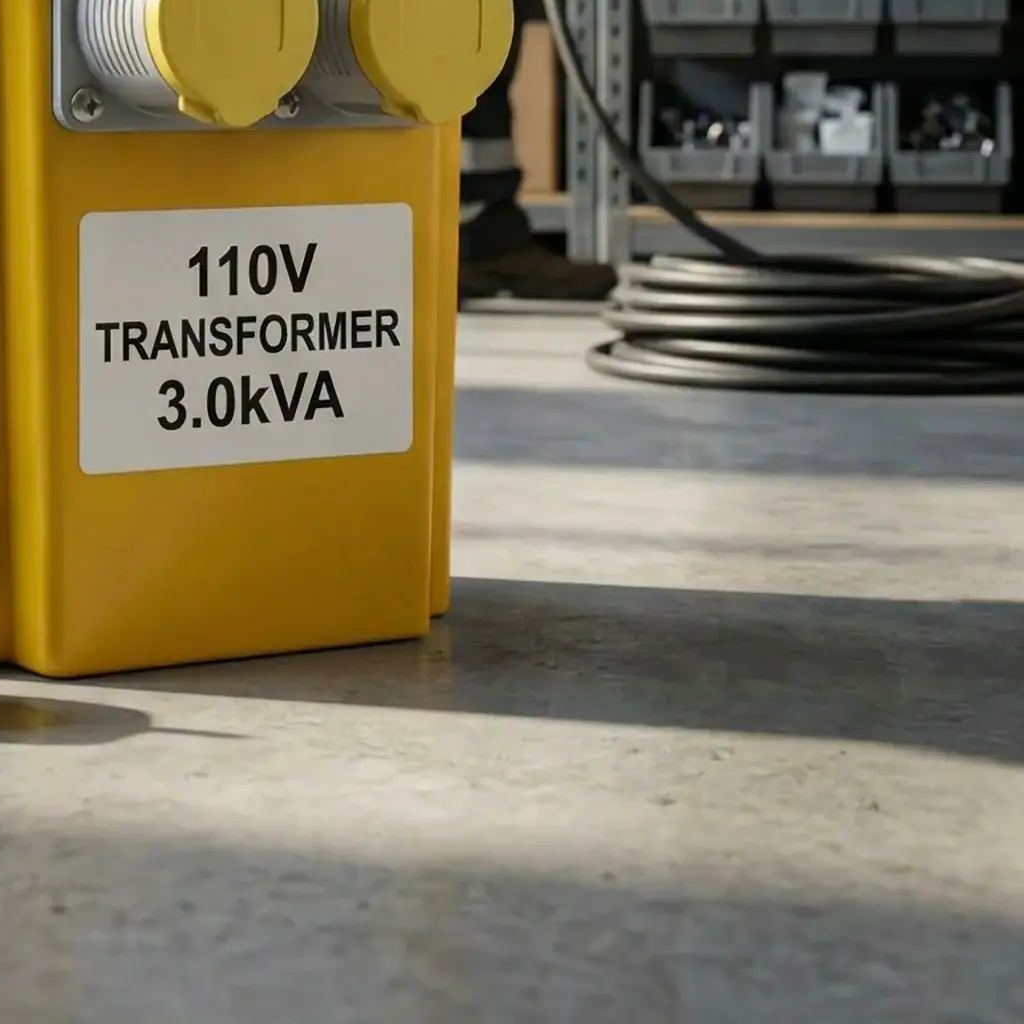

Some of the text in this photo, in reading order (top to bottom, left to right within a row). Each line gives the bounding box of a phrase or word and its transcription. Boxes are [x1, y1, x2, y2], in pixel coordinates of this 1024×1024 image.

[189, 243, 317, 296] 110V
[96, 310, 400, 362] TRANSFORMER
[158, 371, 344, 430] 3.0kVA
